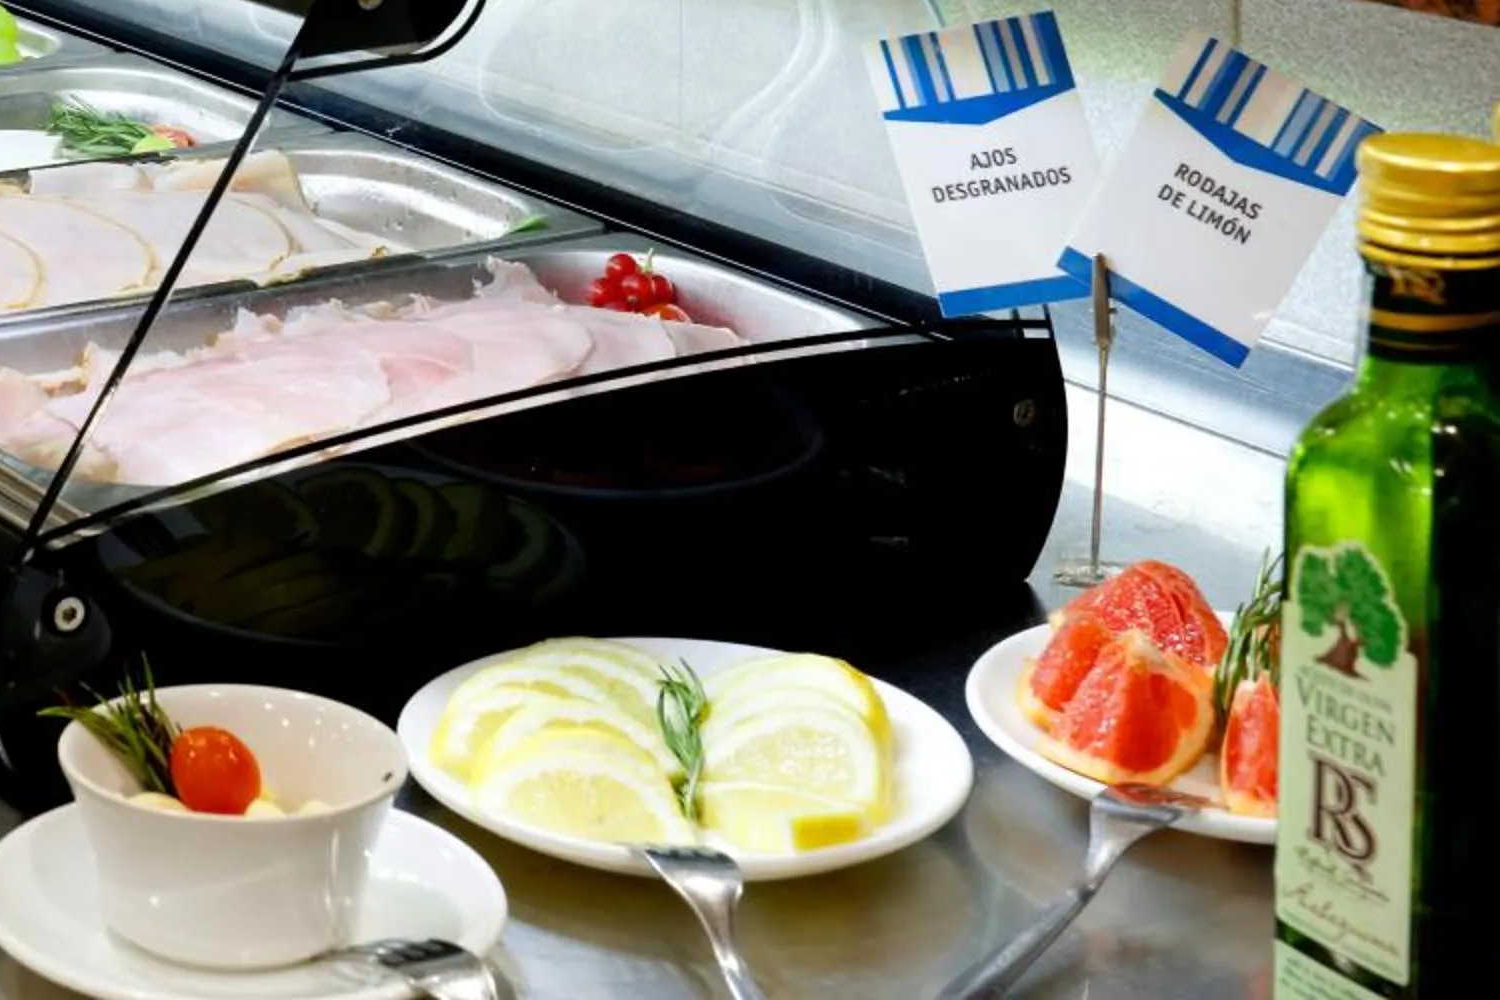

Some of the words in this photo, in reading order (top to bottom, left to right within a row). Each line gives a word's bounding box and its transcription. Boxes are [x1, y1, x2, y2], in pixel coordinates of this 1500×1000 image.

[932, 166, 1072, 203] DESGRANADOS
[970, 147, 1018, 171] AJOS
[1156, 183, 1182, 209] DE
[1187, 198, 1251, 245] LIMÓN
[1173, 162, 1263, 221] RODAJAS
[1295, 673, 1397, 748] VIRGEN
[1306, 712, 1387, 777] EXTRA
